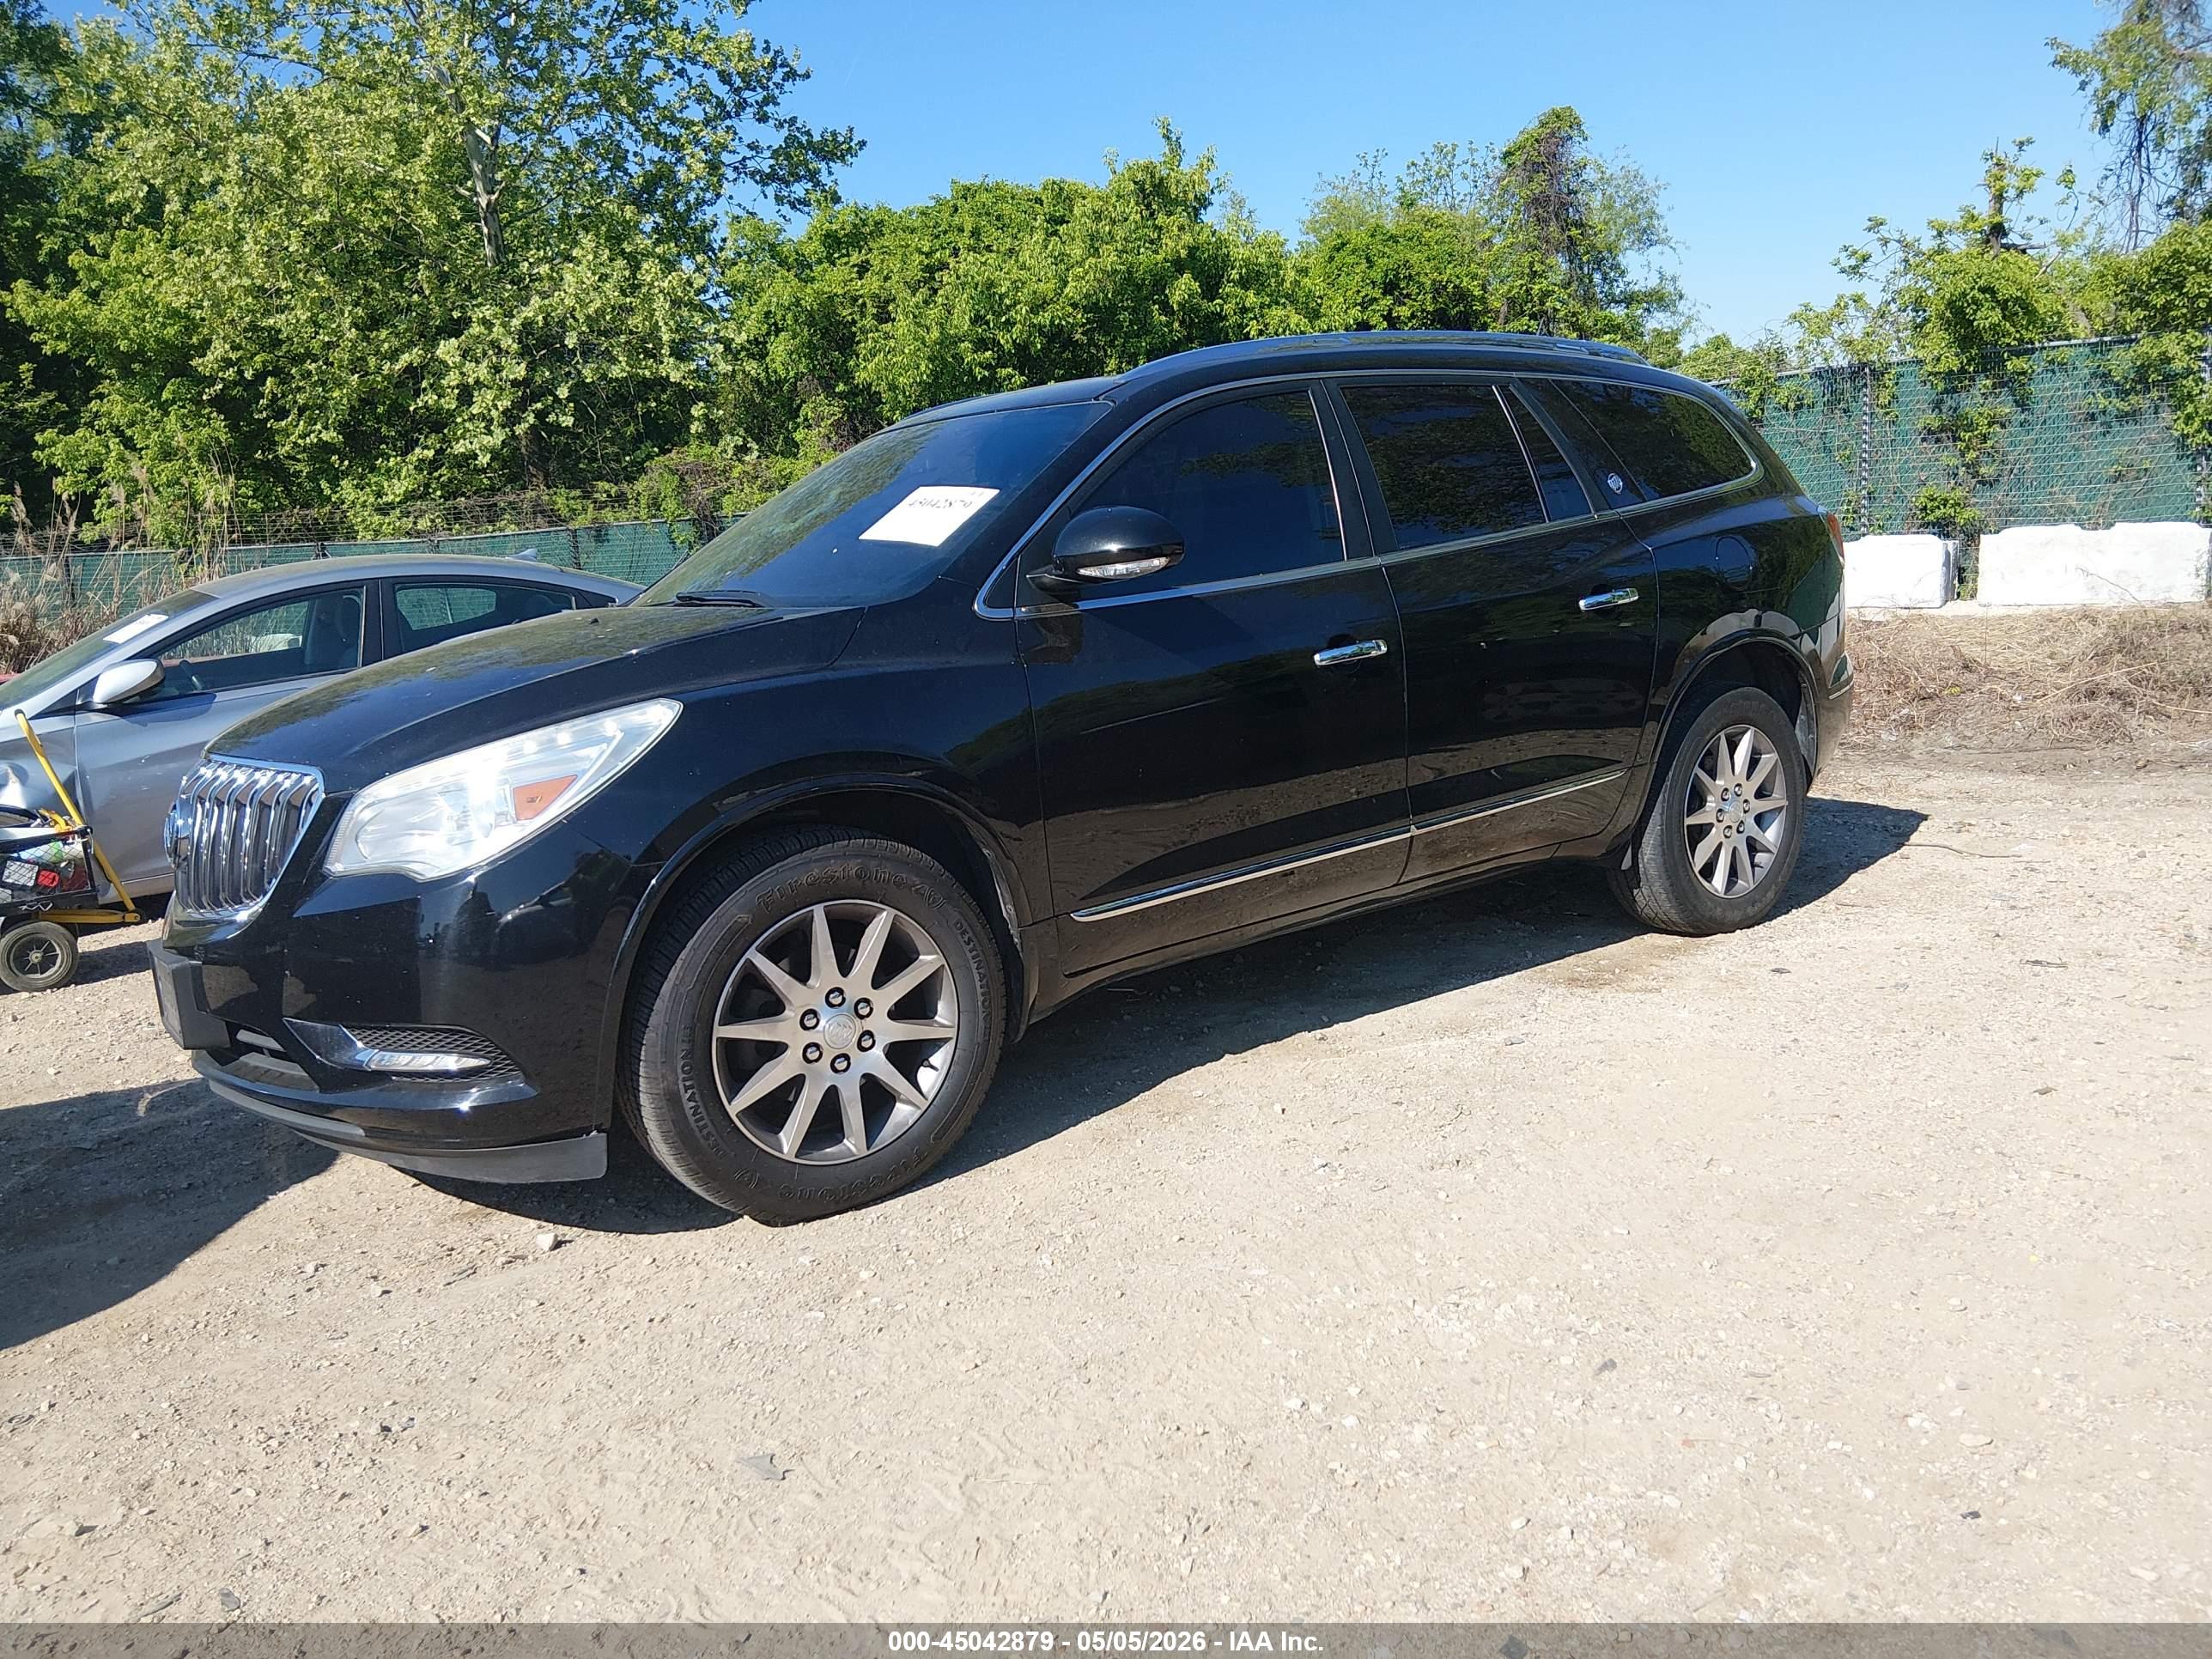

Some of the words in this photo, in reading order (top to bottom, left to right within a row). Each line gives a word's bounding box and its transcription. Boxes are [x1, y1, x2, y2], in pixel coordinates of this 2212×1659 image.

[756, 862, 908, 914] Firestone
[953, 919, 991, 1021] DESTINATION
[679, 1048, 729, 1161] DESTINATION
